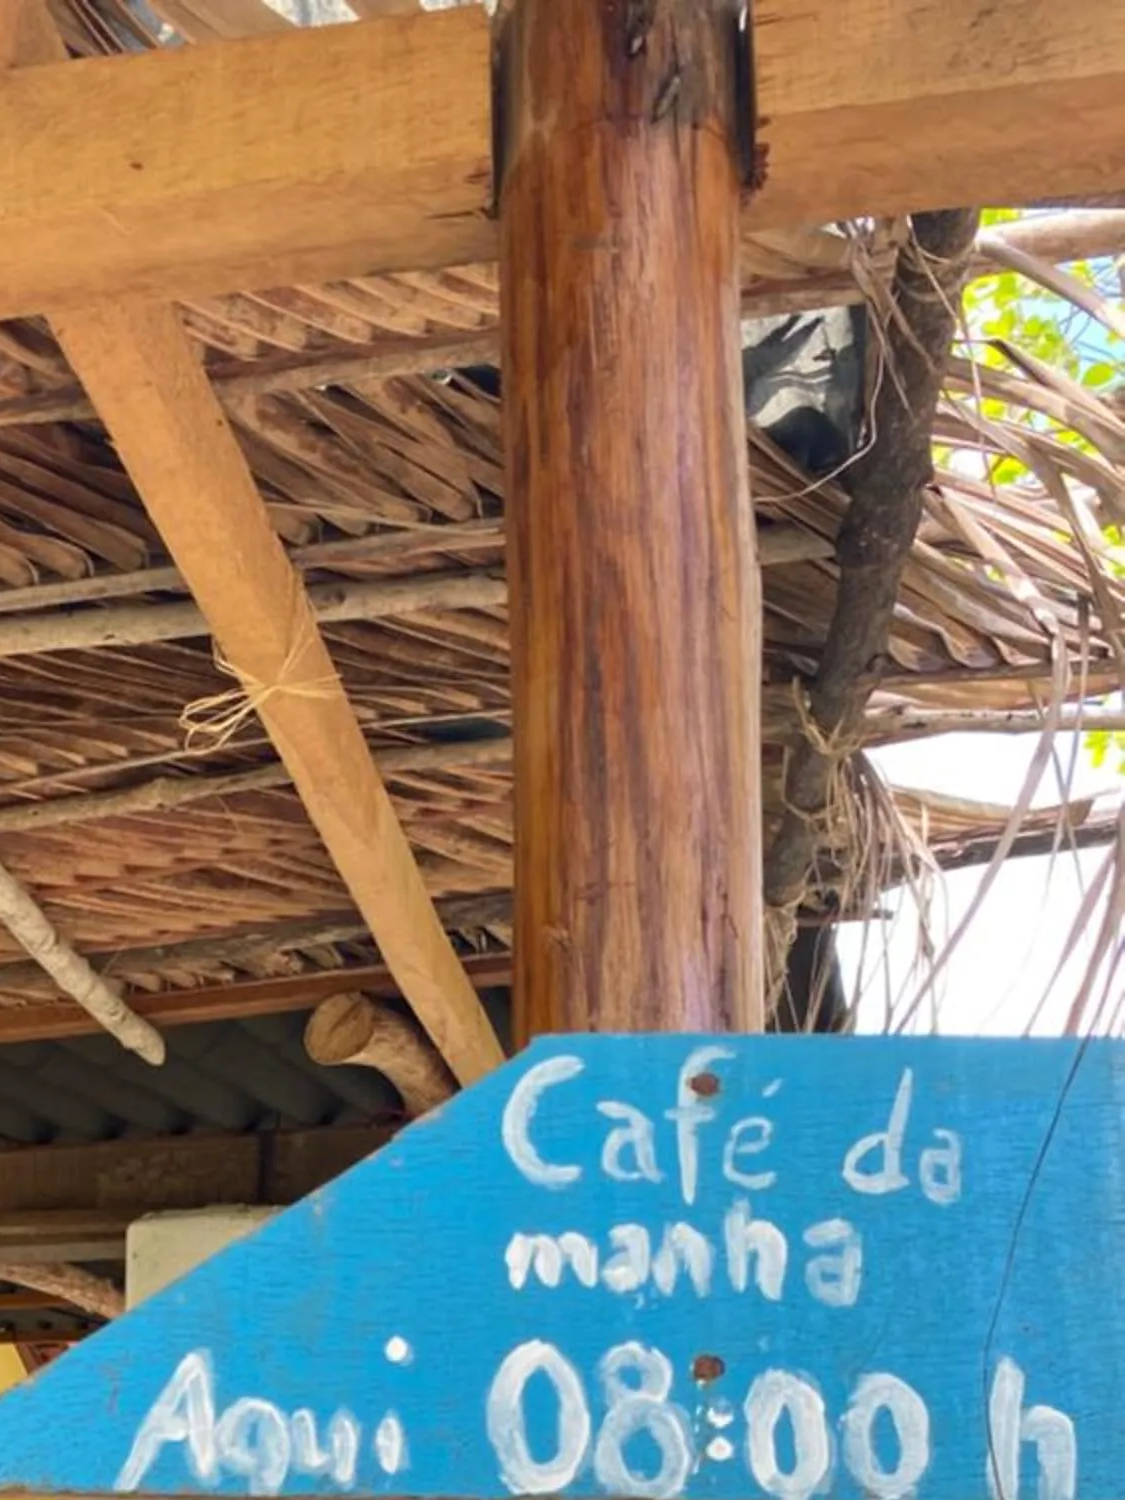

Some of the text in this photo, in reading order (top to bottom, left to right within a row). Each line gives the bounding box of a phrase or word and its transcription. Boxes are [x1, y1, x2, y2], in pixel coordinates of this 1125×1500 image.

[502, 1046, 962, 1204] Café da
[504, 1197, 864, 1307] manha
[112, 1335, 413, 1497] Aqui
